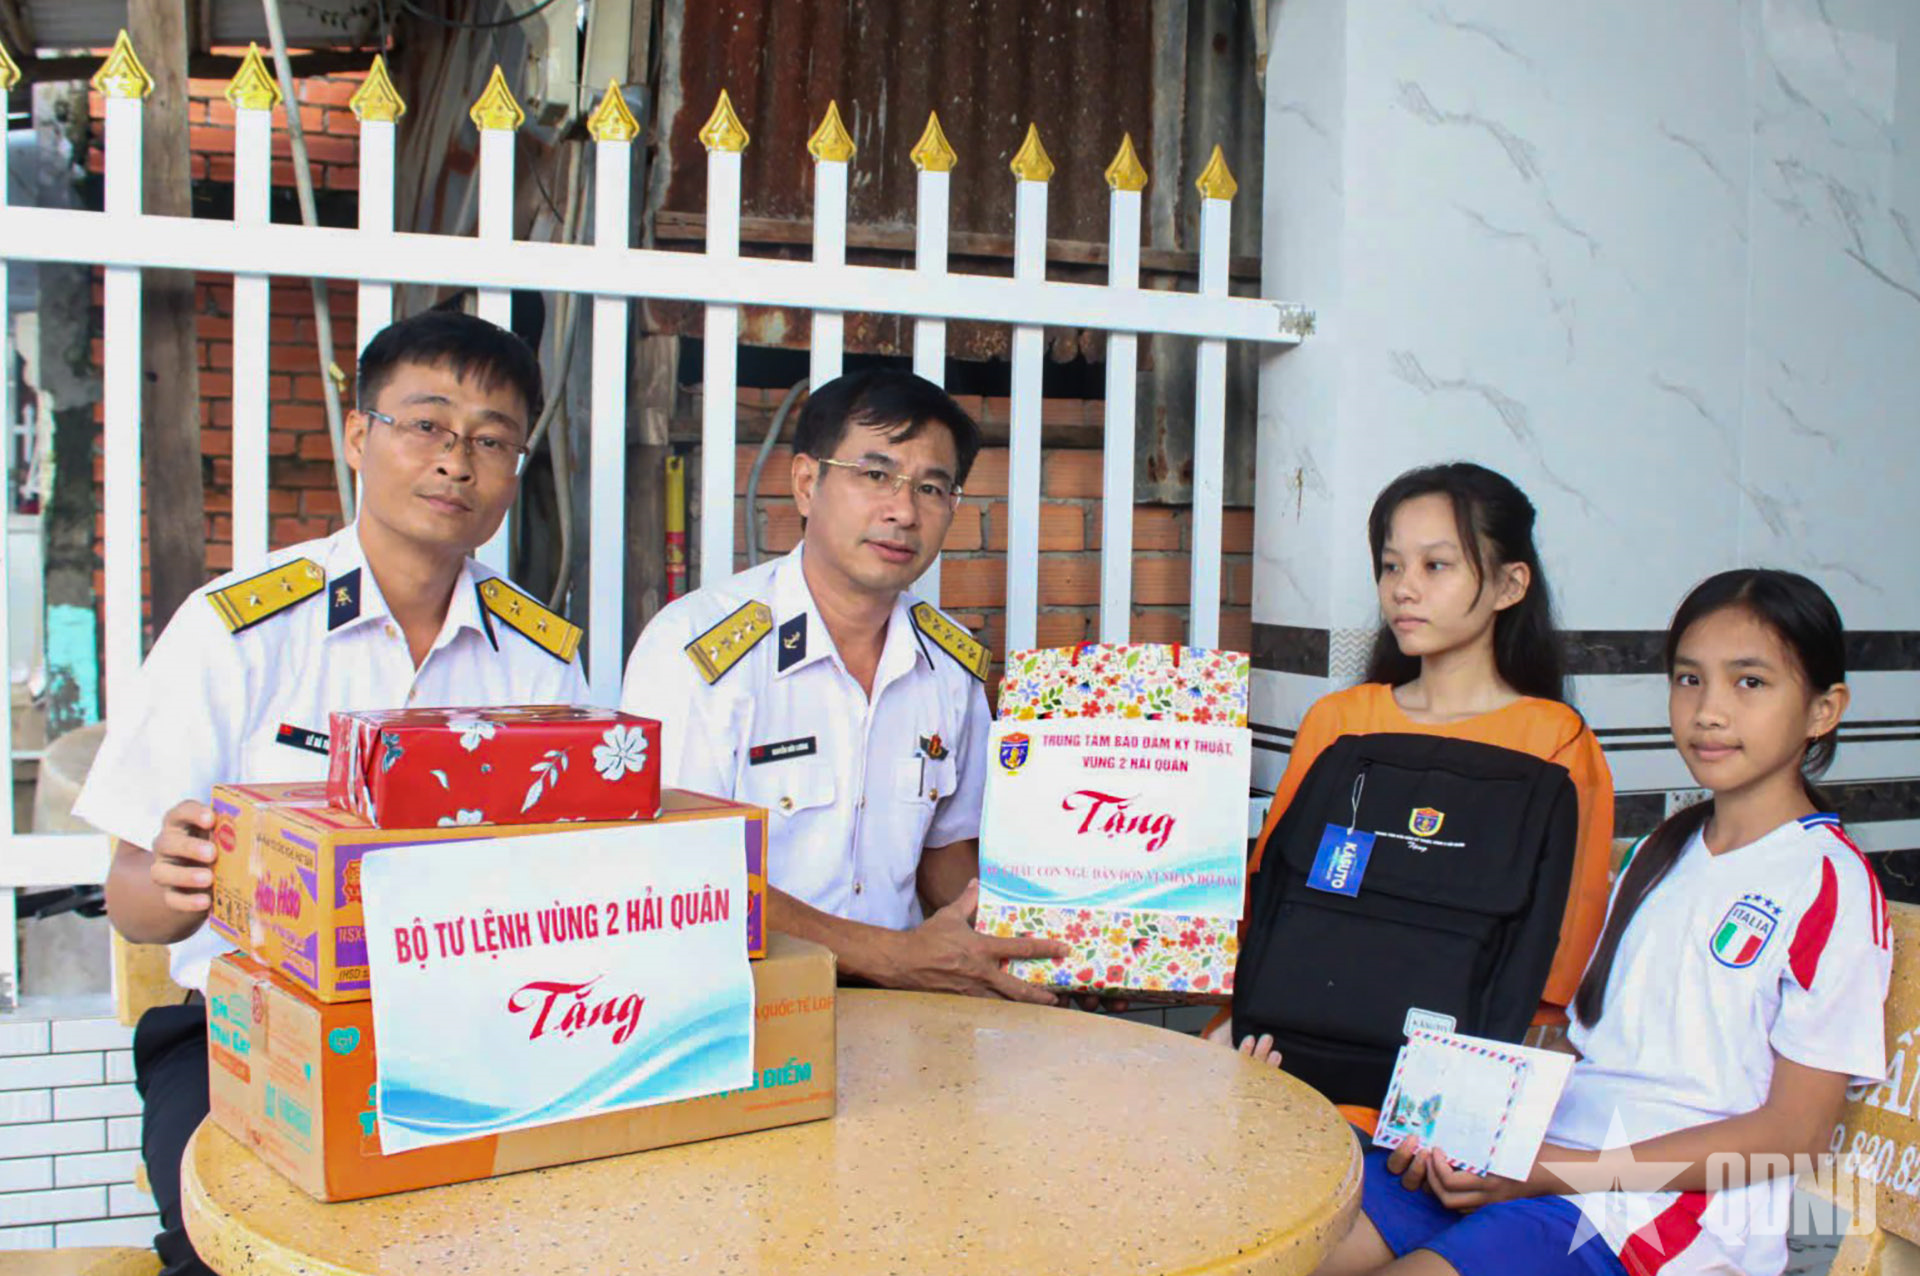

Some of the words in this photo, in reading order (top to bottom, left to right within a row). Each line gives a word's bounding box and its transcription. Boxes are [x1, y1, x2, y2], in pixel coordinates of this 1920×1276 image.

[1119, 757, 1127, 770] 2
[1062, 790, 1176, 852] Tặng
[395, 917, 429, 969] BỘ
[434, 916, 465, 958] TƯ
[471, 908, 532, 959] LỆNH
[537, 900, 598, 945] VÙNG
[606, 902, 620, 935] 2
[627, 886, 663, 933] HẢI
[670, 884, 730, 930] QUÂN
[1732, 908, 1770, 934] ITALIA
[508, 974, 645, 1044] Tặng
